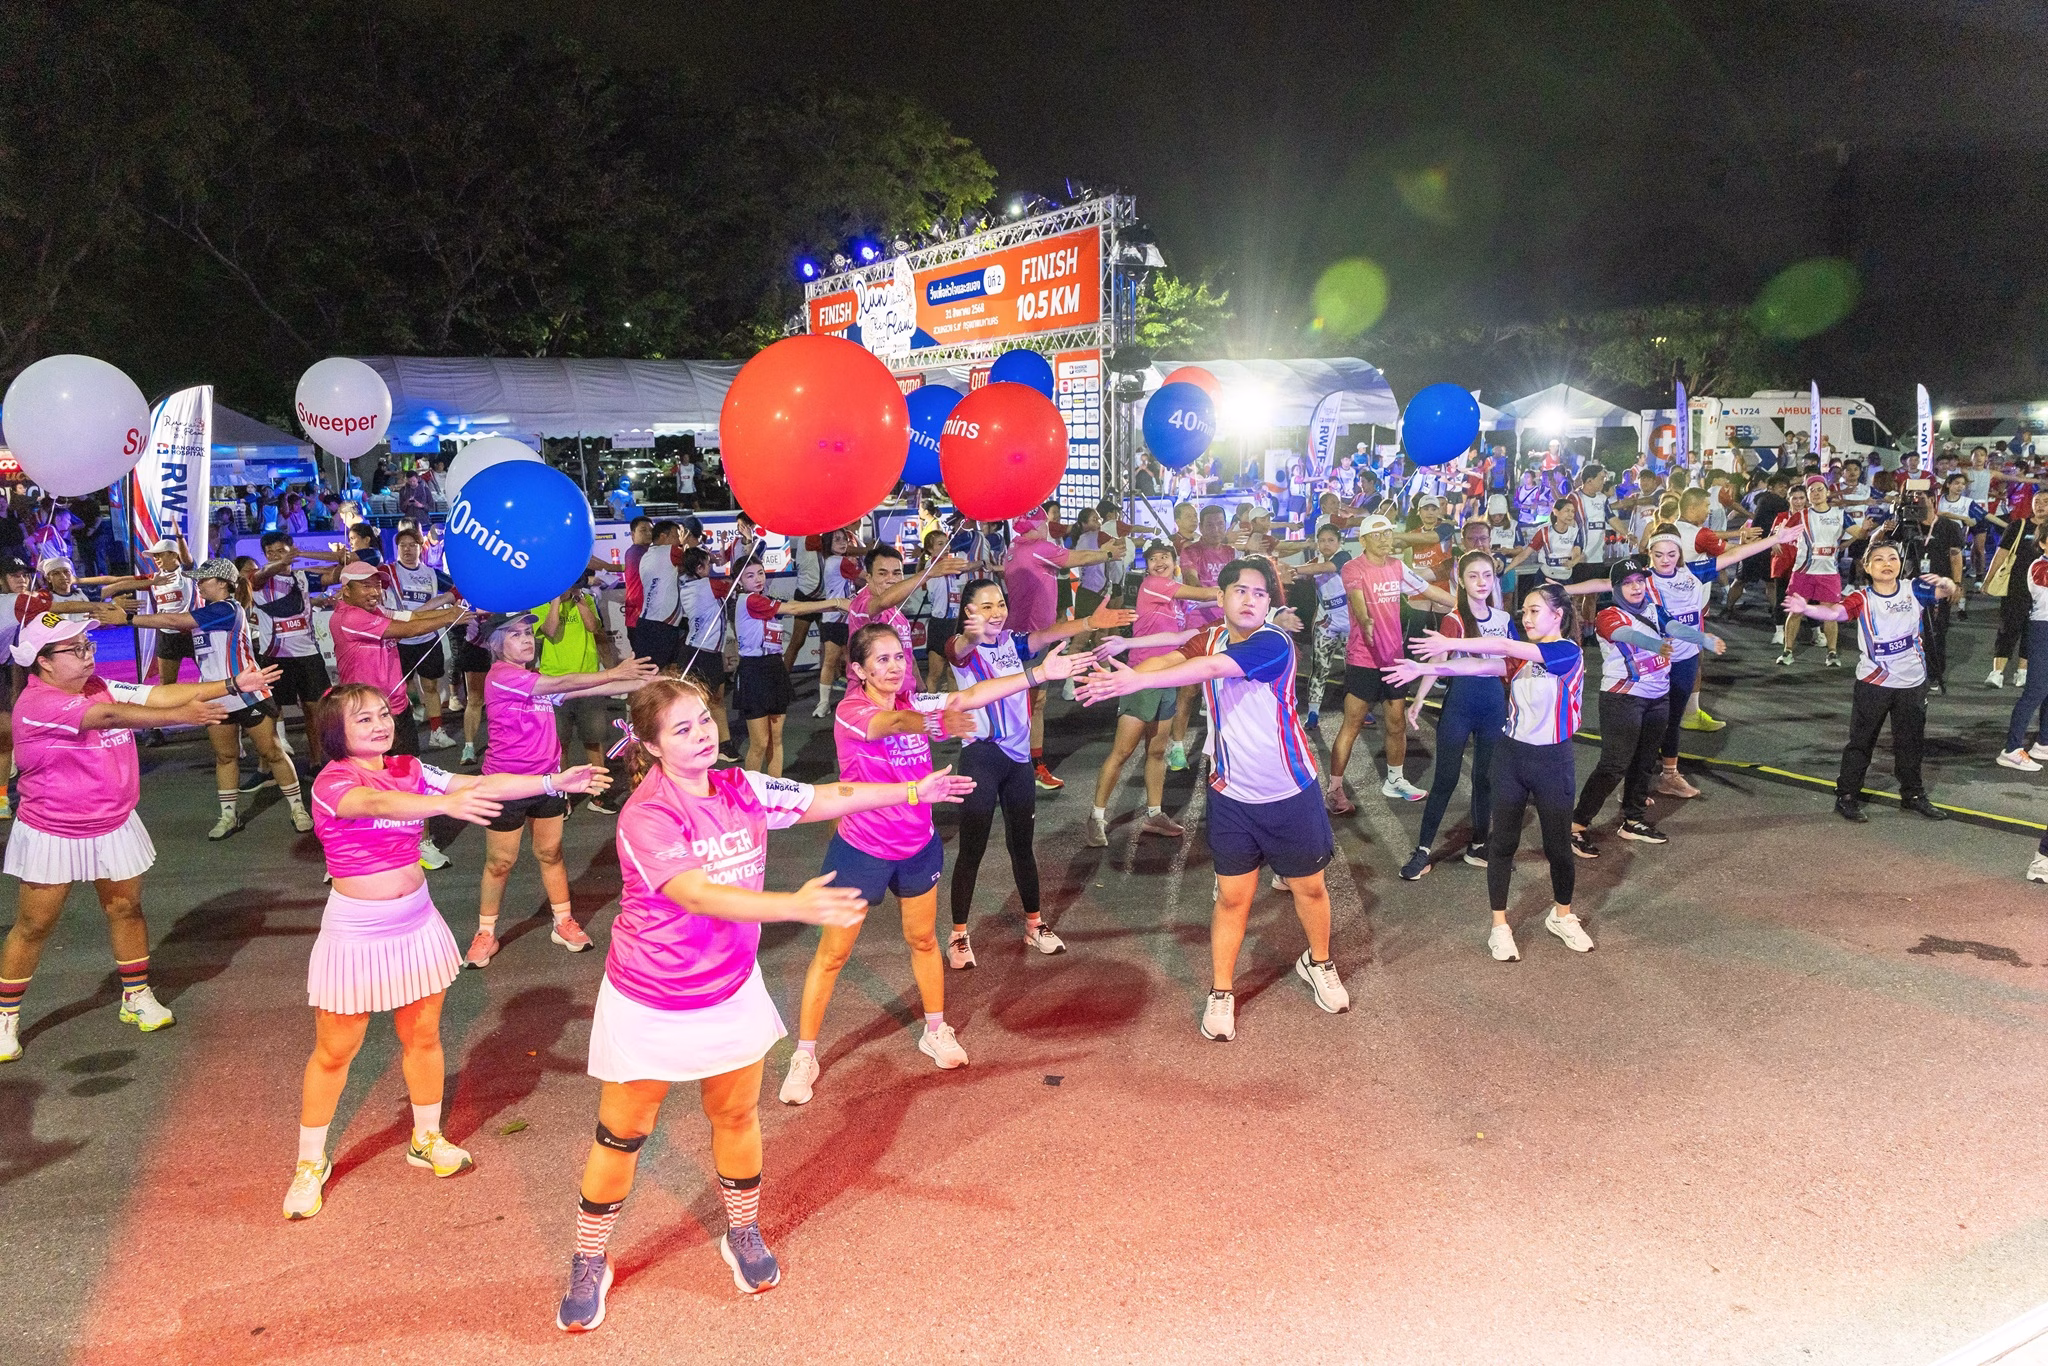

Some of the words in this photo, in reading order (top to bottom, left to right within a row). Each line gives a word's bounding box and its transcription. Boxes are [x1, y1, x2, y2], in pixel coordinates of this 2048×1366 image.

[1021, 246, 1079, 285] FINISH
[997, 275, 1002, 286] 2
[1016, 289, 1049, 322] 10.5
[1050, 283, 1080, 317] KM
[819, 301, 853, 327] FINISH
[1740, 407, 1760, 415] 1724
[1777, 406, 1843, 415] AMBULNCE
[297, 402, 377, 436] Sweeper
[171, 444, 205, 452] BANGKOK
[286, 619, 301, 628] 1045
[1888, 639, 1907, 651] 5334
